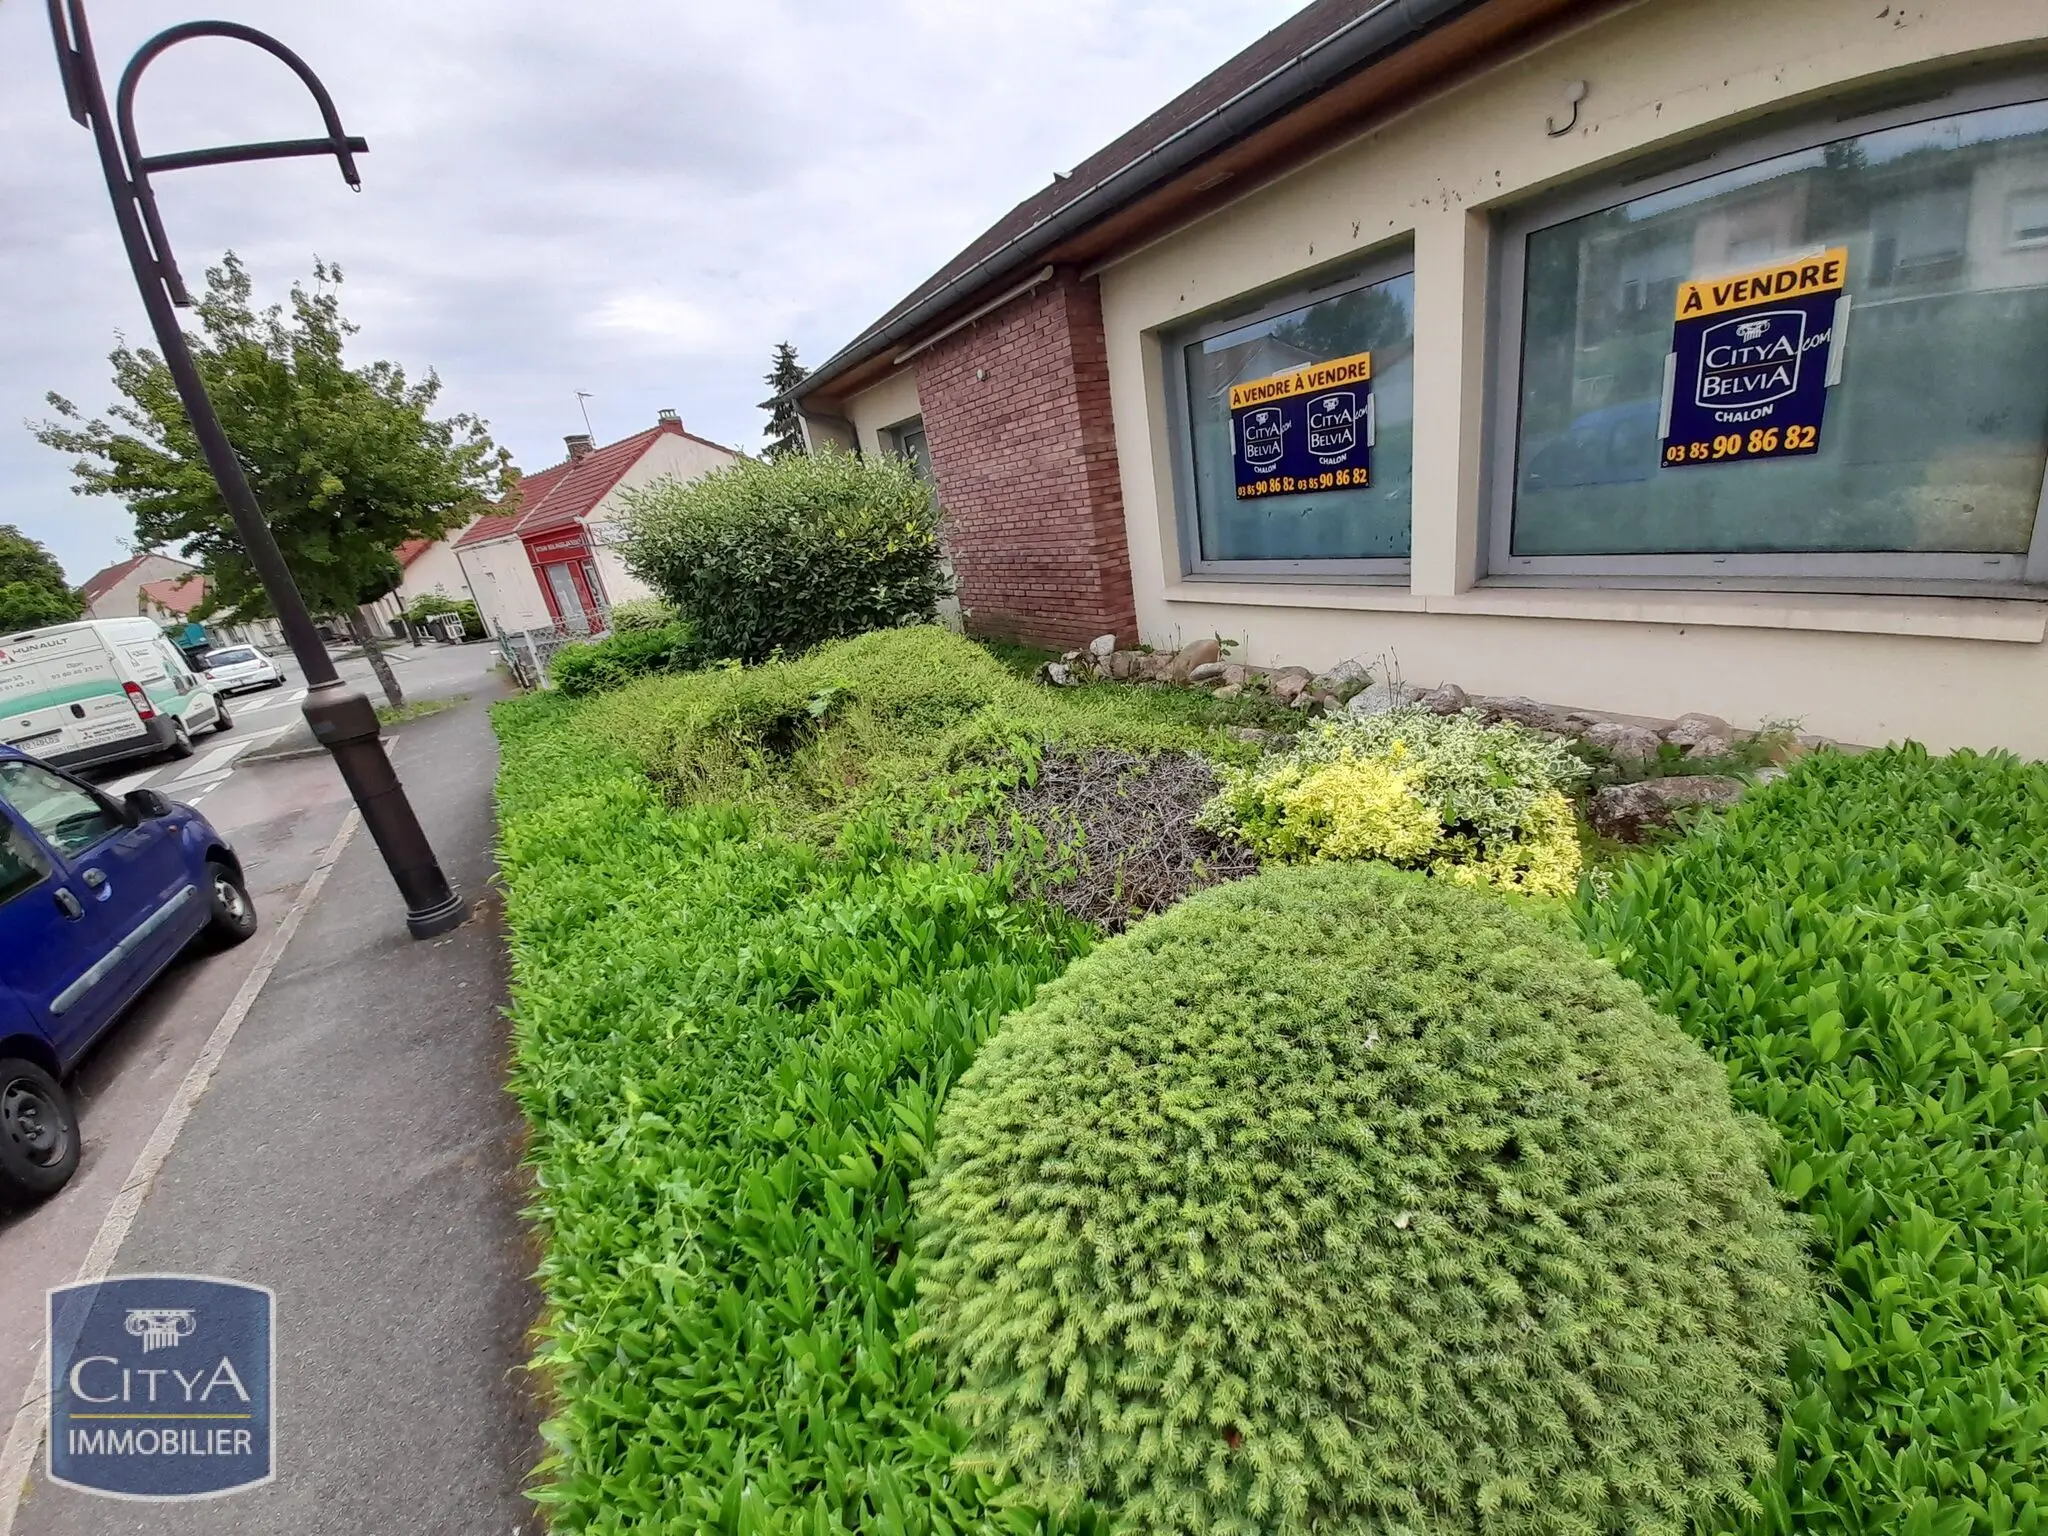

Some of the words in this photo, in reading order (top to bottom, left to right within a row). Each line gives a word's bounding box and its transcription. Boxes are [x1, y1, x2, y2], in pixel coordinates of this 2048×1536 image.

[1683, 287, 1703, 314] À
[1712, 260, 1840, 306] VENDRE
[1232, 390, 1242, 406] À
[1243, 379, 1291, 402] VENDRE
[1294, 373, 1305, 392] À
[1306, 360, 1366, 388] VENDRE
[1714, 403, 1774, 423] CHALON
[1666, 446, 1685, 462] 03
[1689, 442, 1710, 459] 85
[1712, 433, 1743, 459] 90
[1747, 427, 1780, 454] 86
[1784, 424, 1817, 450] 82
[1254, 463, 1277, 473] CHALON
[1319, 453, 1347, 465] CHALON
[1238, 487, 1246, 496] 03
[1246, 484, 1256, 496] 85
[1255, 480, 1267, 496] 90
[1269, 478, 1281, 493] 86
[1282, 476, 1295, 492] 82
[1297, 479, 1308, 491] 03
[1308, 475, 1319, 489] 85
[1319, 472, 1334, 489] 90
[1335, 469, 1350, 486] 86
[1352, 467, 1367, 484] 82
[12, 638, 68, 655] HUNAULT
